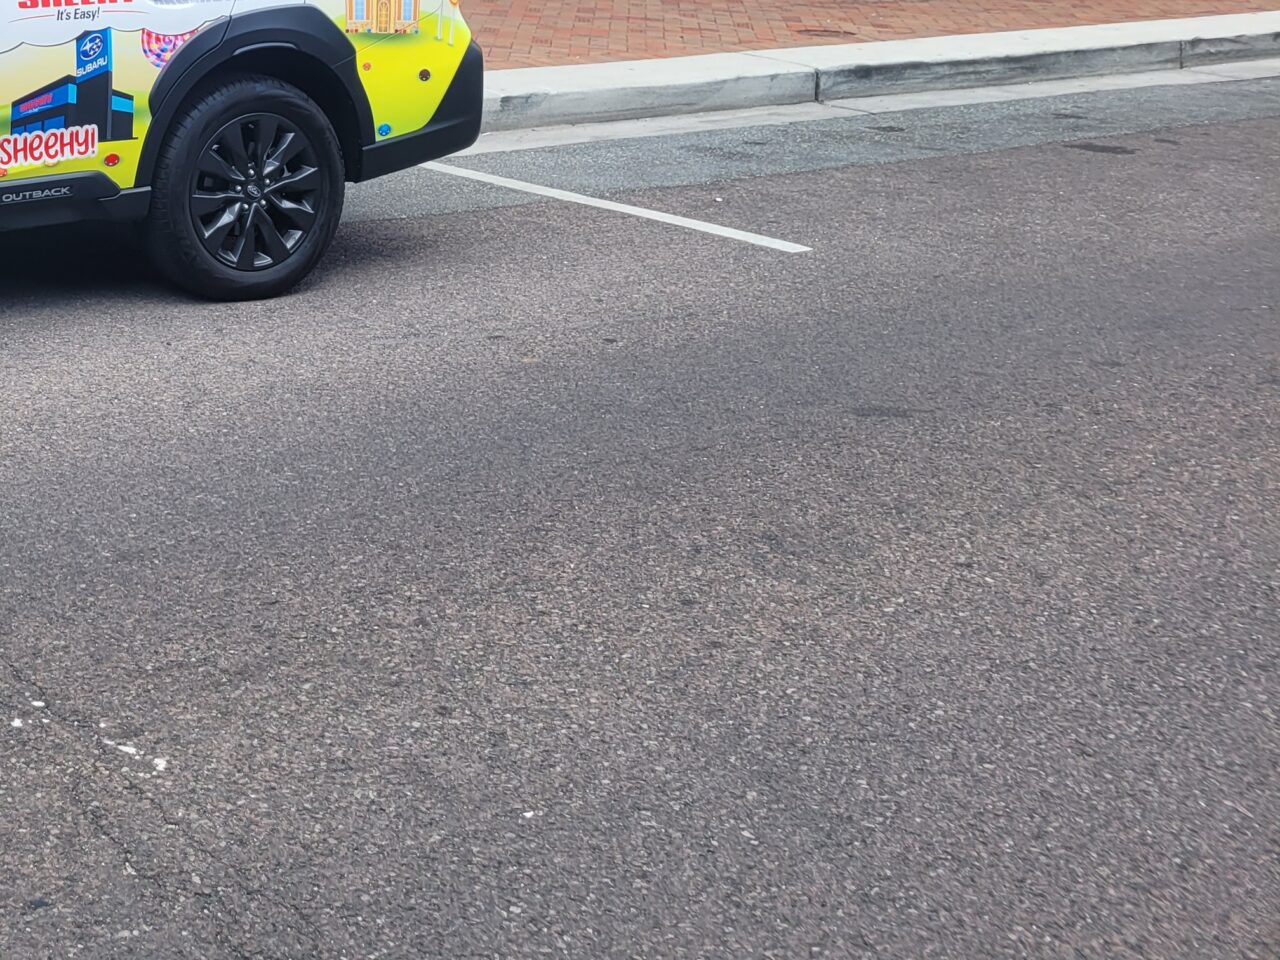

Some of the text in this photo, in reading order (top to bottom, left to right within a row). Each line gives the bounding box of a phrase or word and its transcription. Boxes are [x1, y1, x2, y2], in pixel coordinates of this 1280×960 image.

[56, 7, 100, 21] It's Easy!
[76, 55, 108, 77] SUBARU
[1, 186, 71, 203] OUTBACK
